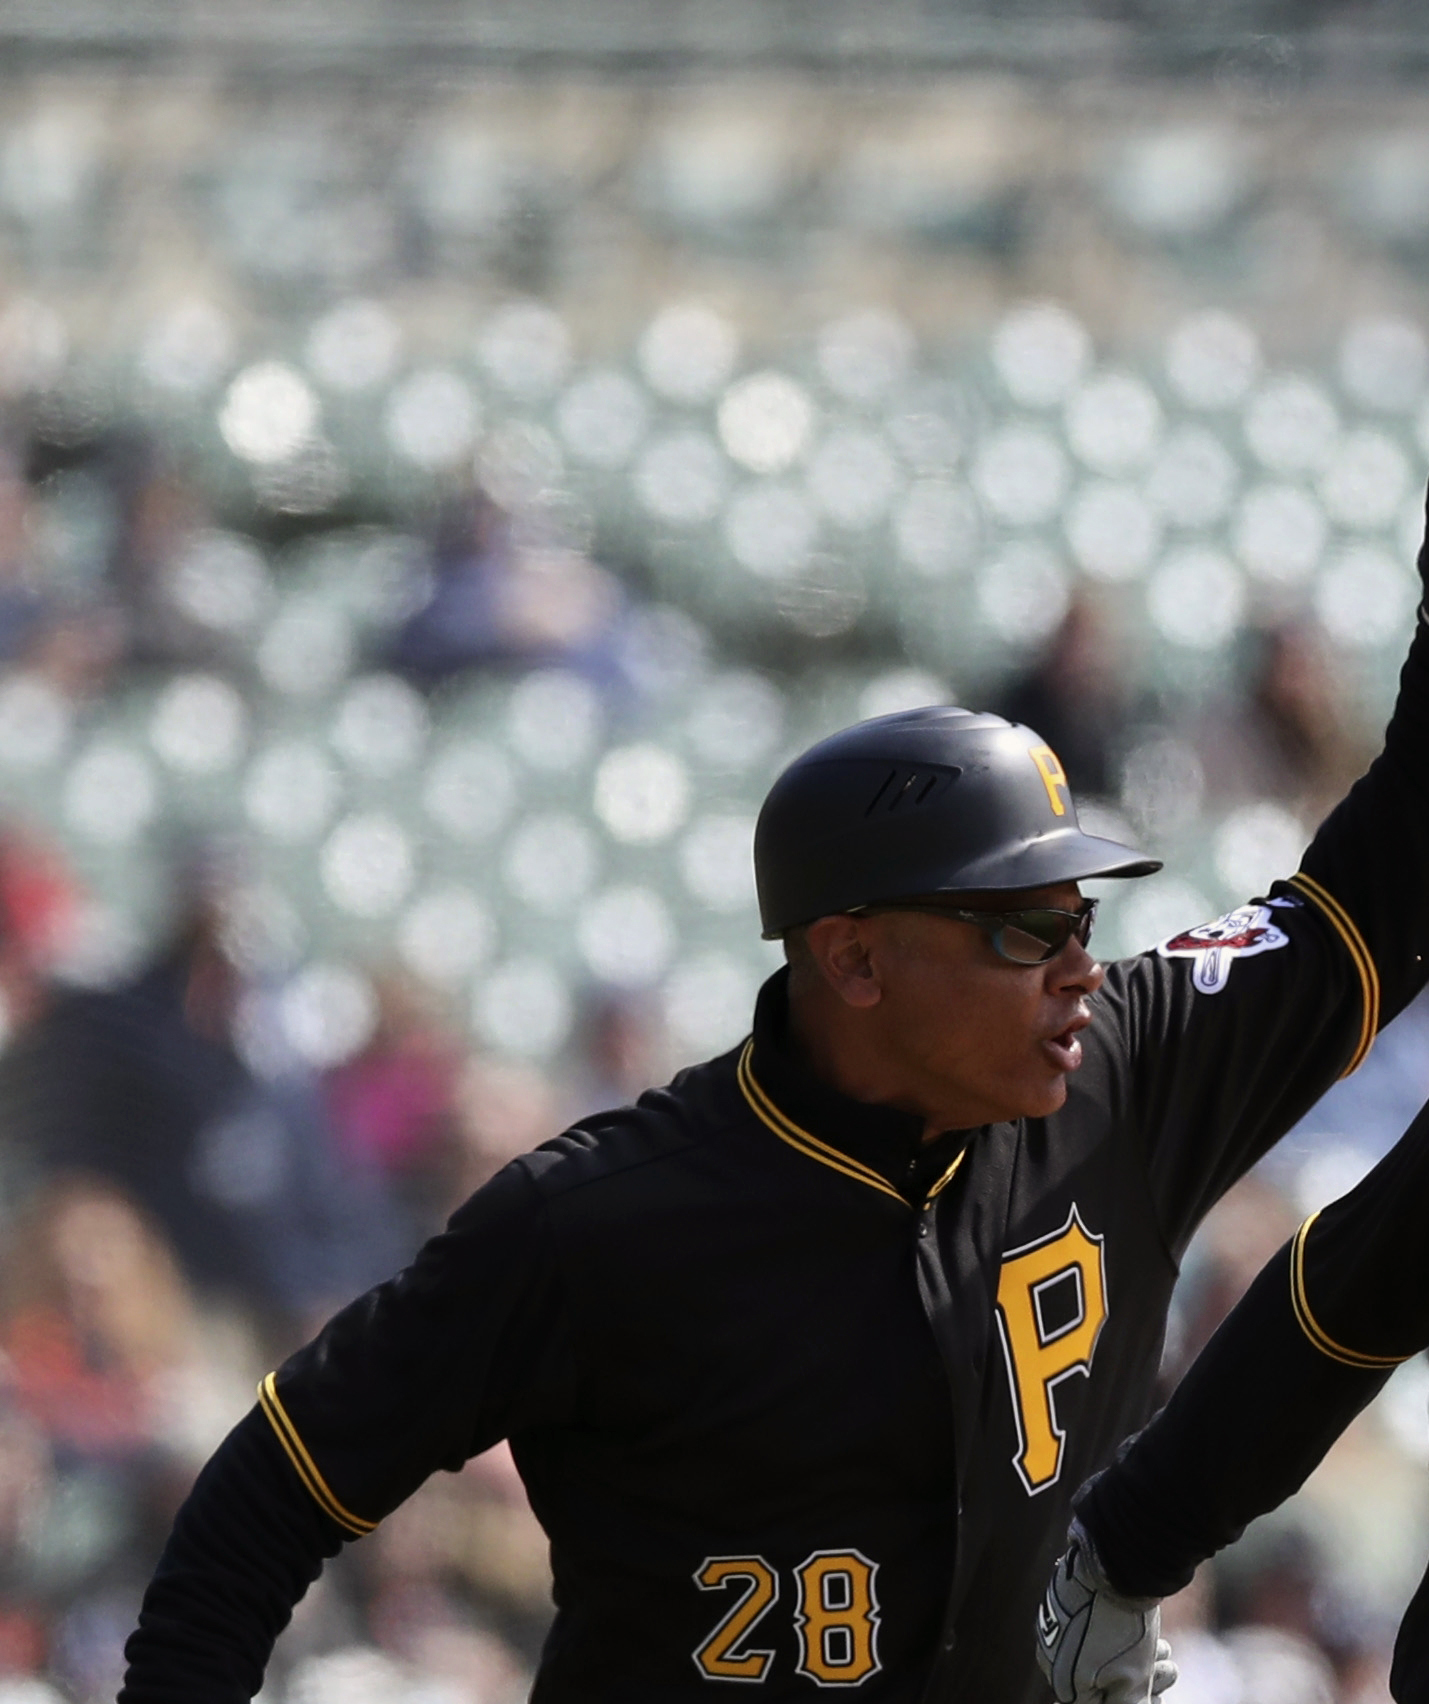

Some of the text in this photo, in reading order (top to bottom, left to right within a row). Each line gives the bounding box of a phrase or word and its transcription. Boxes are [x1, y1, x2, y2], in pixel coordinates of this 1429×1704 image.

[1027, 745, 1068, 816] P
[994, 1201, 1109, 1497] P
[691, 1547, 883, 1688] 28
